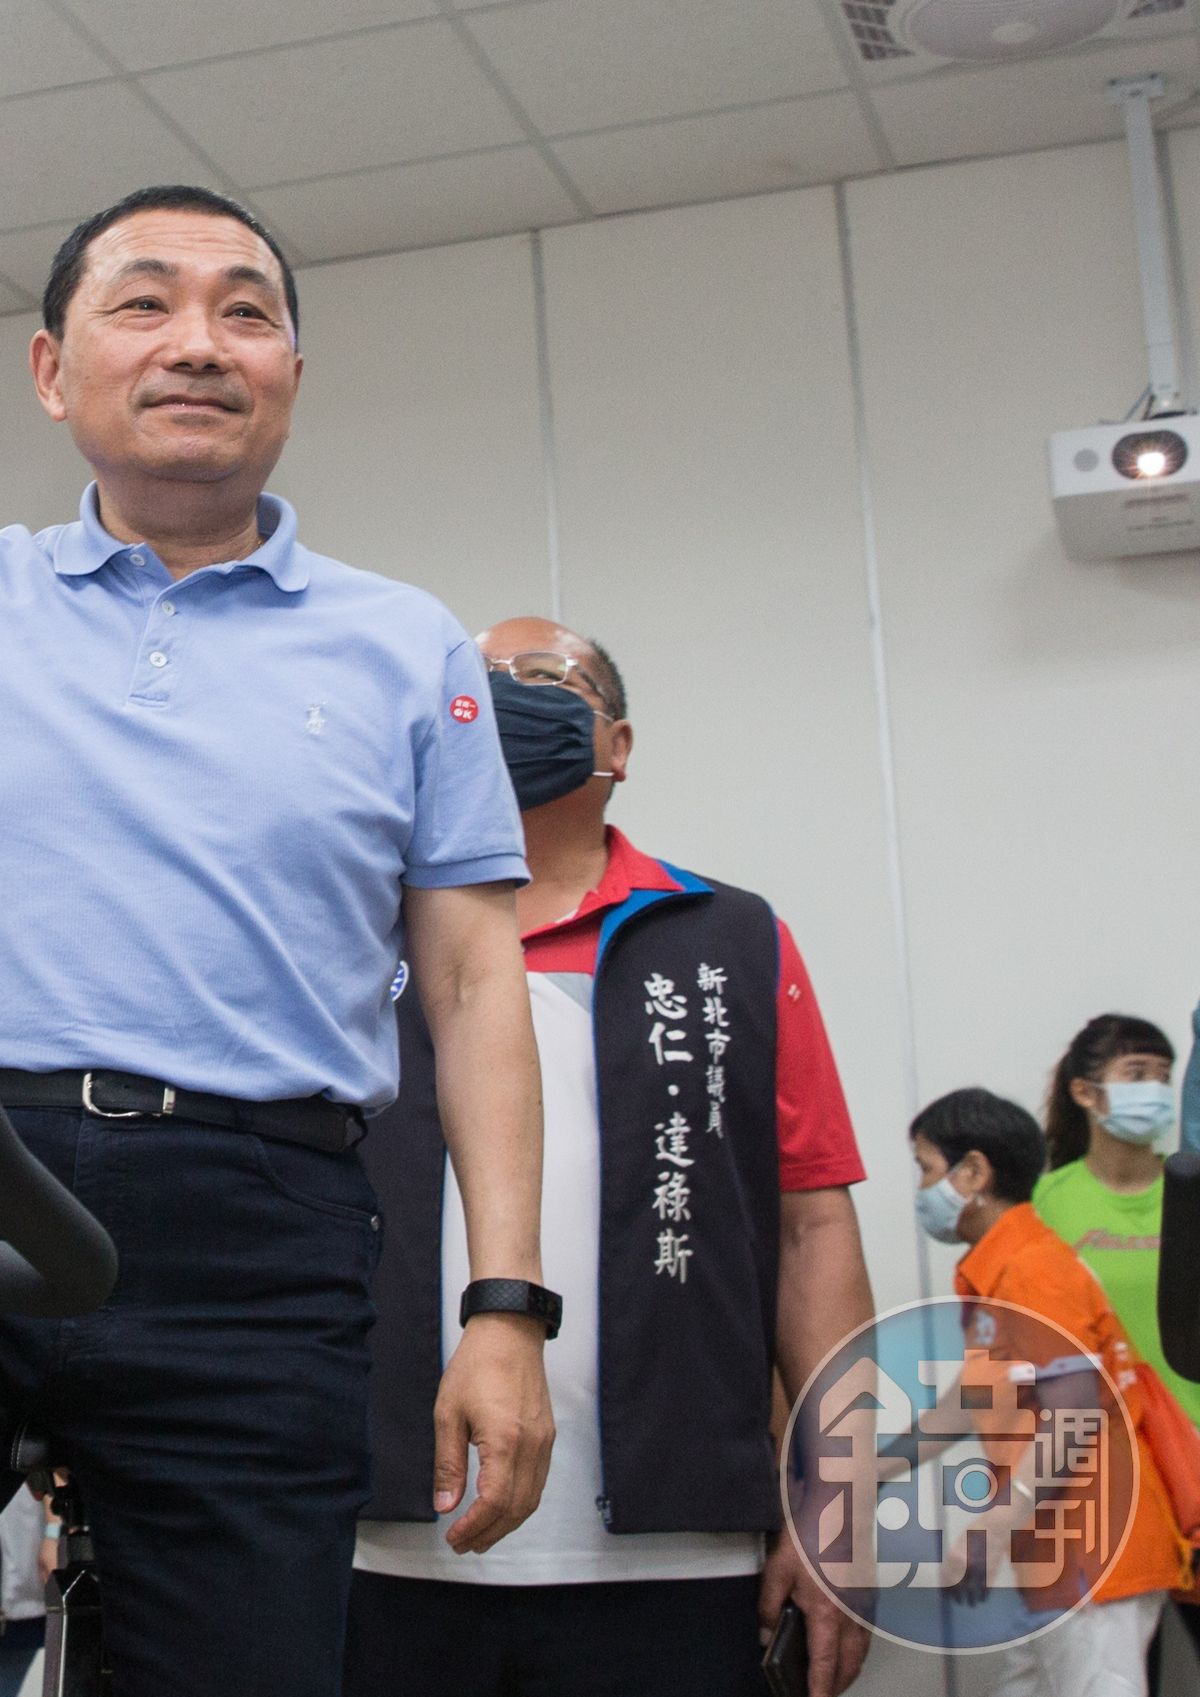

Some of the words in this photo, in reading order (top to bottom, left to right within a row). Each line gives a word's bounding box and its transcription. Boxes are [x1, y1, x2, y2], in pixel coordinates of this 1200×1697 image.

[696, 962, 732, 1139] 新北市議員
